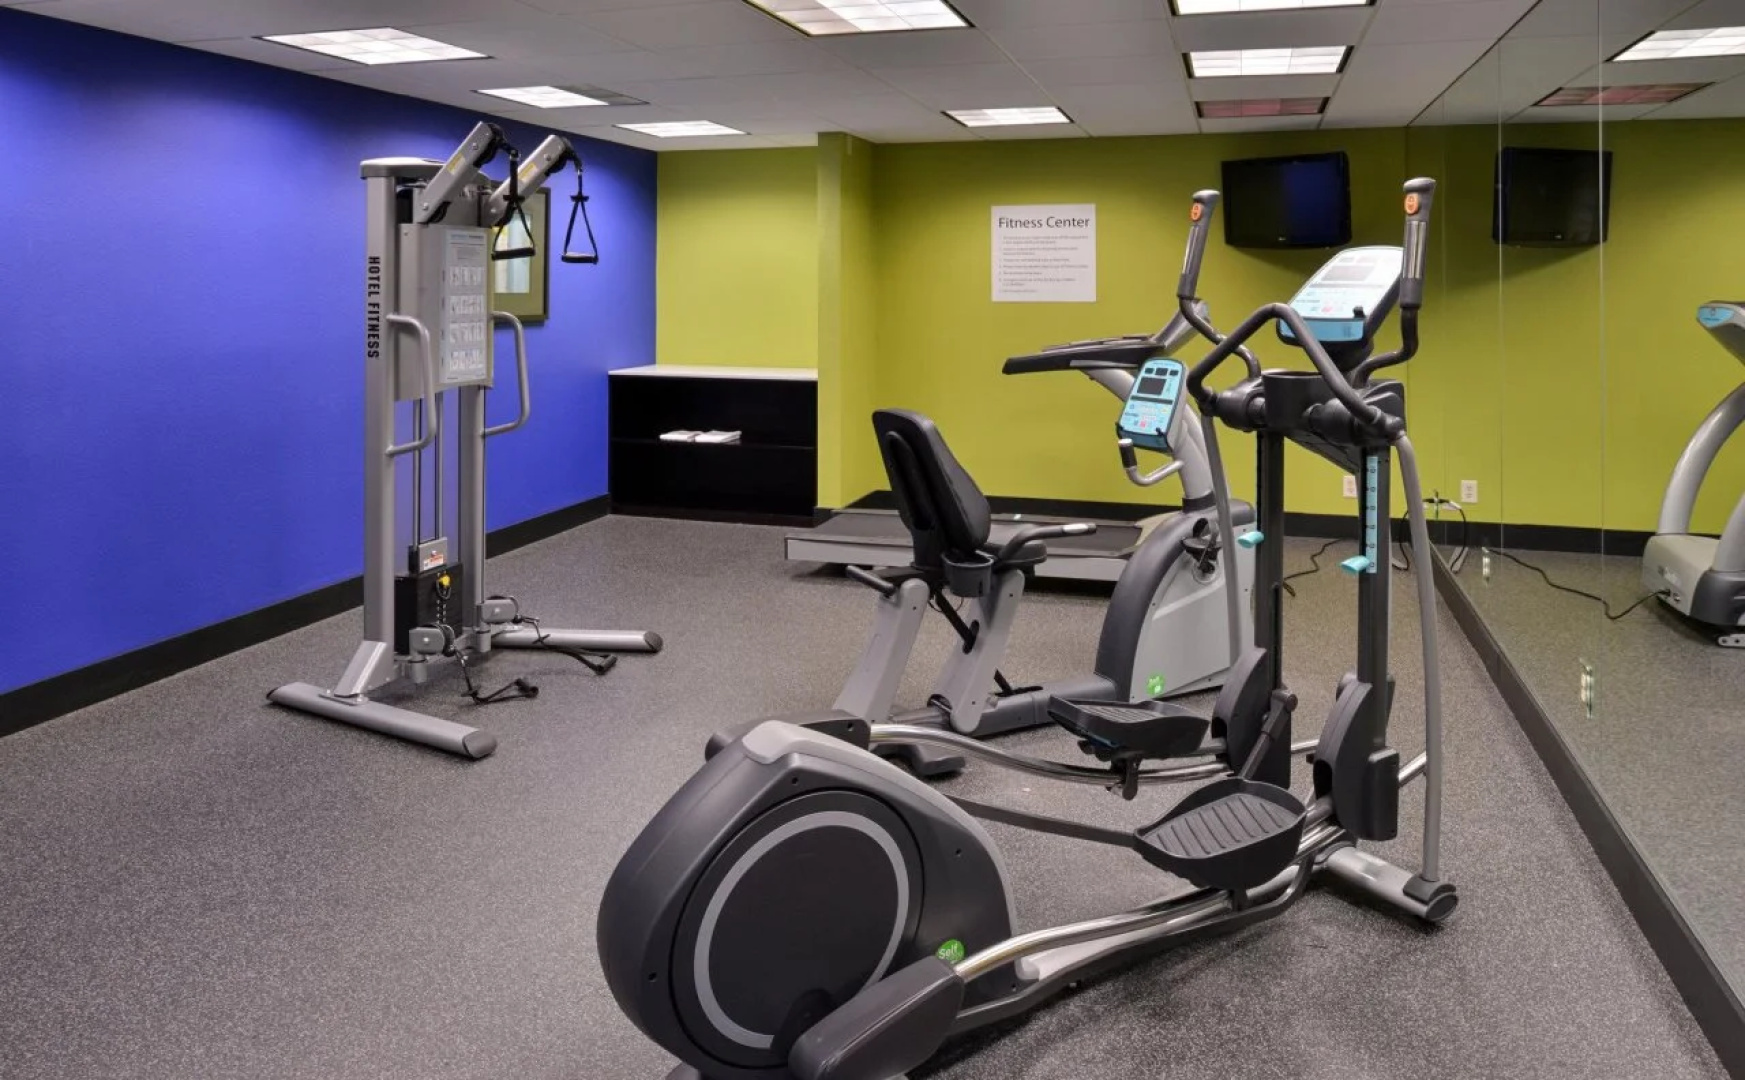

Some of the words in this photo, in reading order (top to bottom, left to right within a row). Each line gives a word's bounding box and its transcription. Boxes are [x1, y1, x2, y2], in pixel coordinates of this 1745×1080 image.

[998, 217, 1043, 229] Fitness
[1046, 216, 1090, 228] Center
[367, 256, 380, 298] HOTEL
[367, 303, 380, 359] FITNESS
